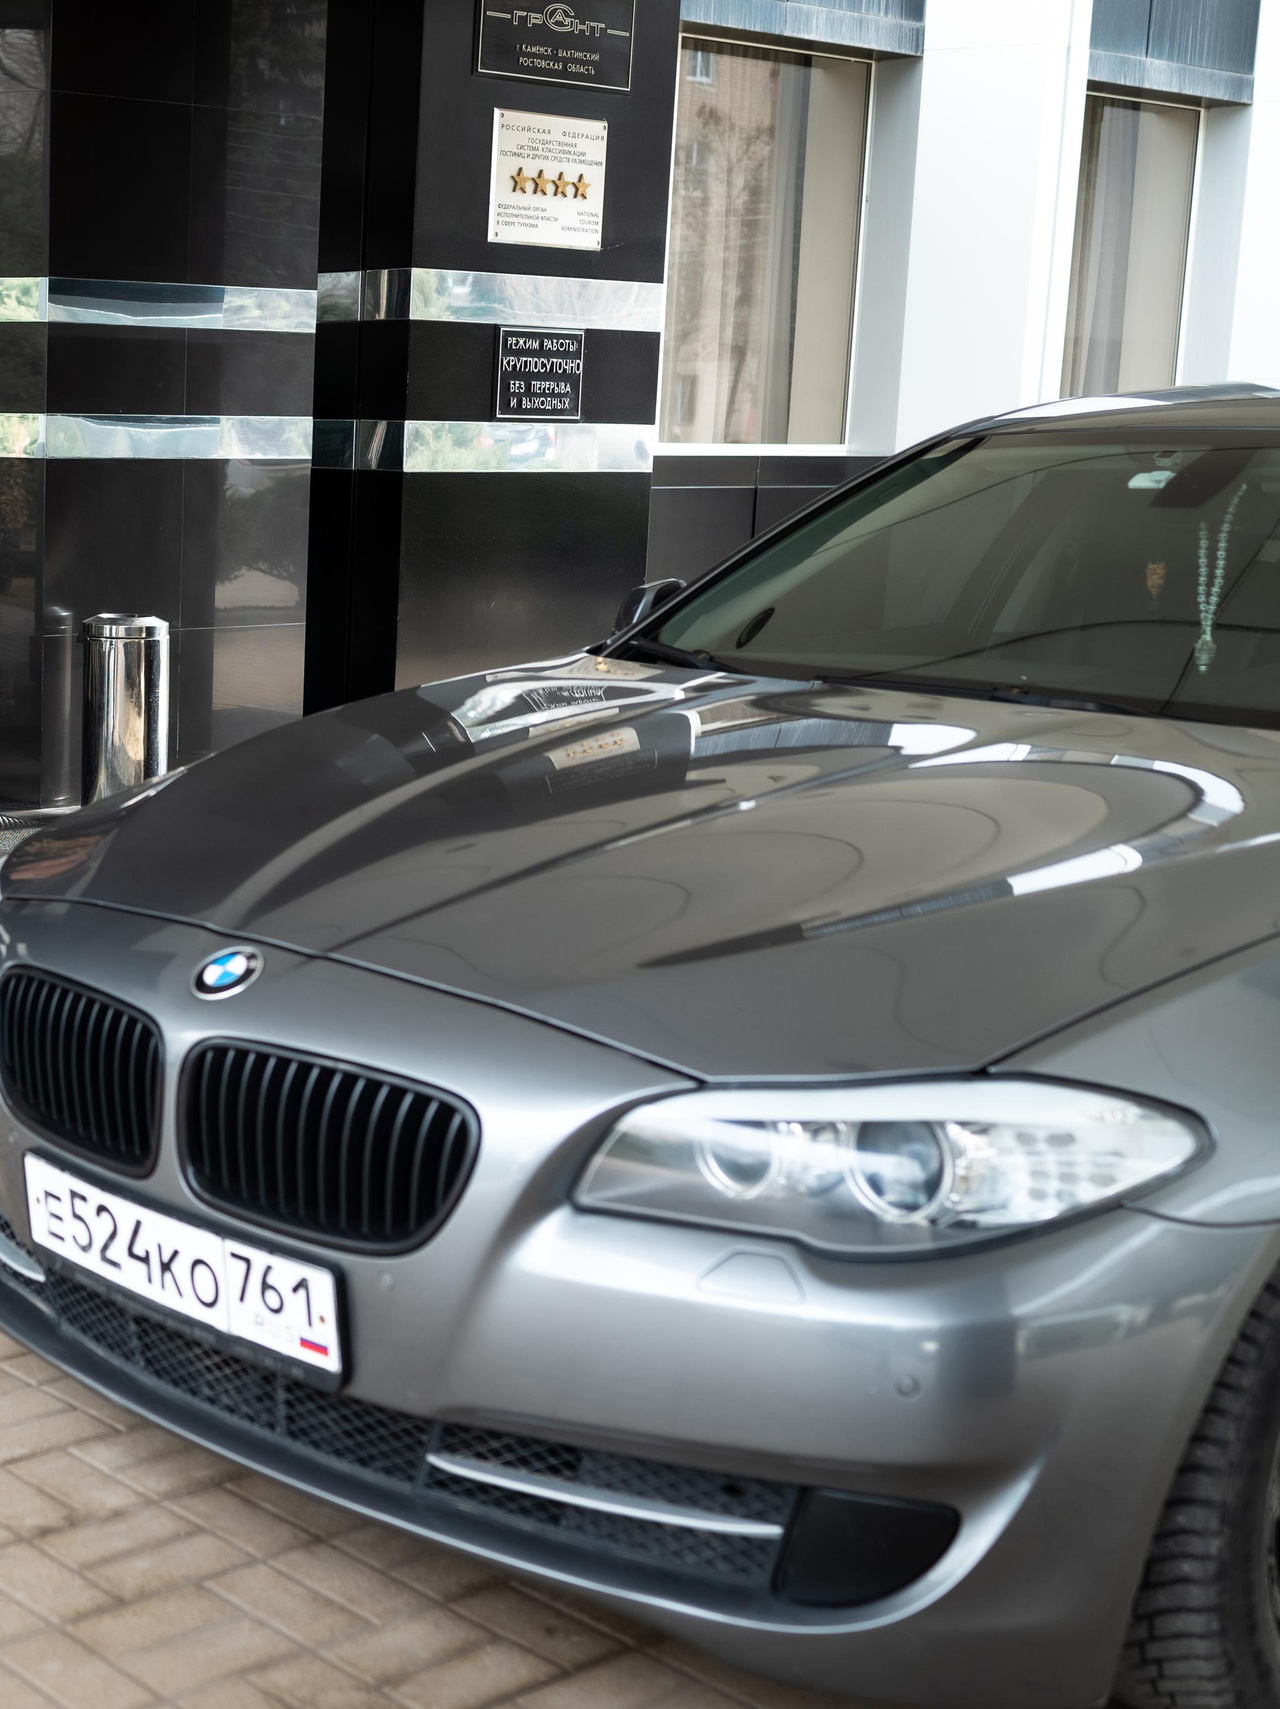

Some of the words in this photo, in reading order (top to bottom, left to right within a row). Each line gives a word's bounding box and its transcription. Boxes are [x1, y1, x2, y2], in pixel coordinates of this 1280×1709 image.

[519, 56, 563, 71] РОСТОВСКАЯ
[567, 64, 595, 75] ОБЛАСТЬ
[500, 123, 552, 135] РОССИЙСКАЯ
[561, 130, 605, 141] ФЕДЕРАЦИЯ
[527, 137, 578, 149] ГОСУДАРСТВЕННАЯ
[516, 143, 540, 153] СИСТЕМА
[541, 146, 587, 158] КЛАССИФИКАЦИИ
[499, 149, 526, 159] ГОСТИНИЦ
[531, 153, 550, 161] ДРУГИХ
[550, 155, 571, 163] СРЕДСТВ
[571, 158, 604, 167] РАЗМЕЩЕНИЯ
[497, 203, 532, 211] ФЕДЕРАЛЬНЫЙ
[496, 212, 540, 221] ИСПОЛНИТЕЛЬНОЙ
[561, 226, 599, 234] ADMINISTRATION
[507, 337, 539, 350] РЕЖИМ
[502, 357, 582, 374] КРУГЛОСУТОЧНО
[509, 381, 525, 393] БЕЗ
[531, 381, 571, 394] ПЕРЕРЫВА
[510, 397, 516, 408] И
[522, 397, 569, 410] ВЫХОДНЫХ
